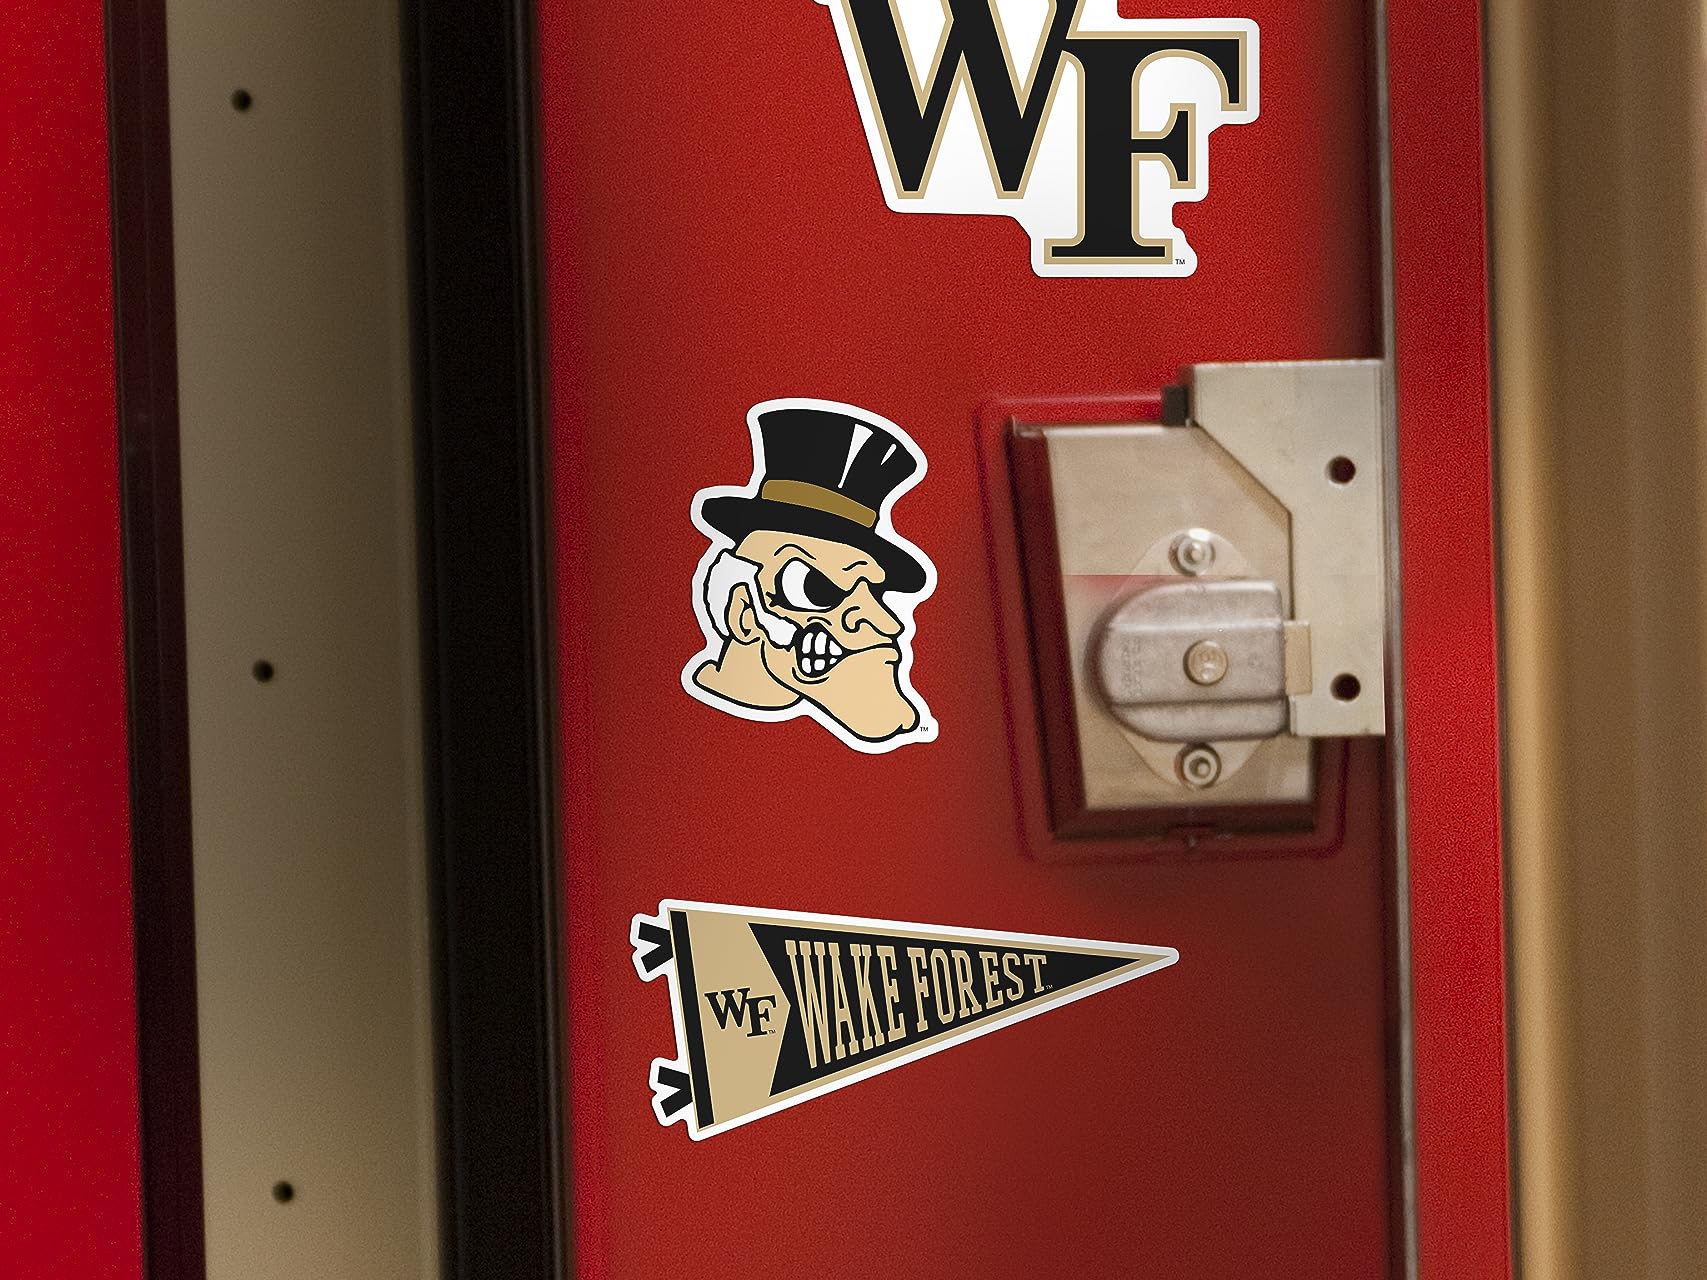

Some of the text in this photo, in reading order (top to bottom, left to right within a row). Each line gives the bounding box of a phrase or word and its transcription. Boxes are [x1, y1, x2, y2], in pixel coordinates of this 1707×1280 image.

[704, 987, 777, 1037] WF
[785, 939, 907, 1069] WAKE
[907, 946, 1047, 1033] FOREST
